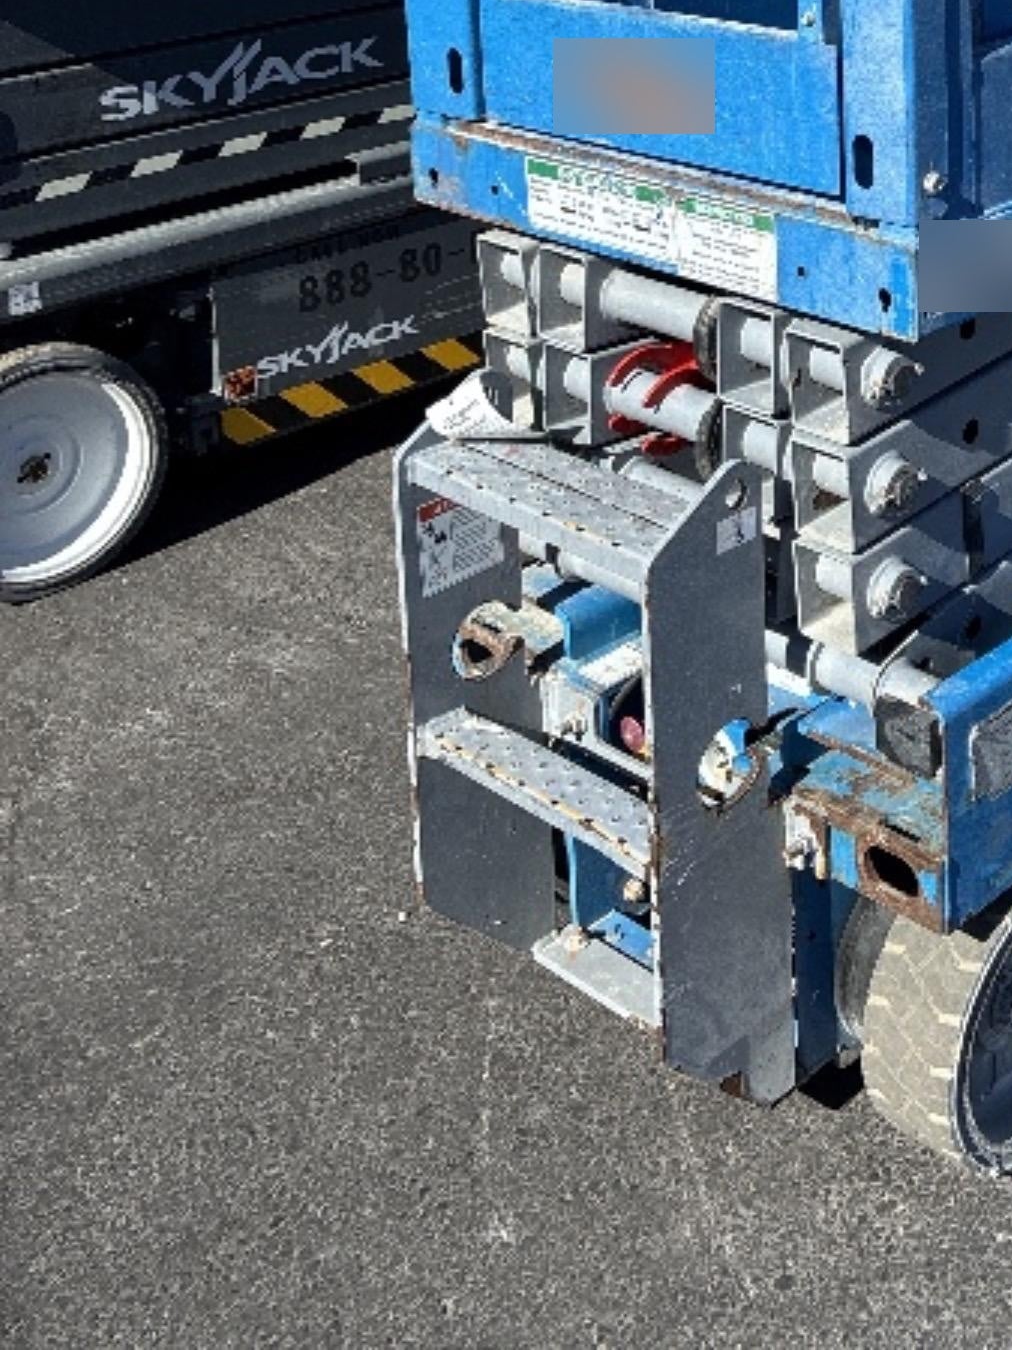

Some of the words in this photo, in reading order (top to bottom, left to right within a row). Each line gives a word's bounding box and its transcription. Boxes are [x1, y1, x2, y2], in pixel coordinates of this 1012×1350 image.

[100, 37, 384, 122] SKYJACK
[300, 230, 477, 312] 888-80-
[257, 314, 421, 379] SKYJACK
